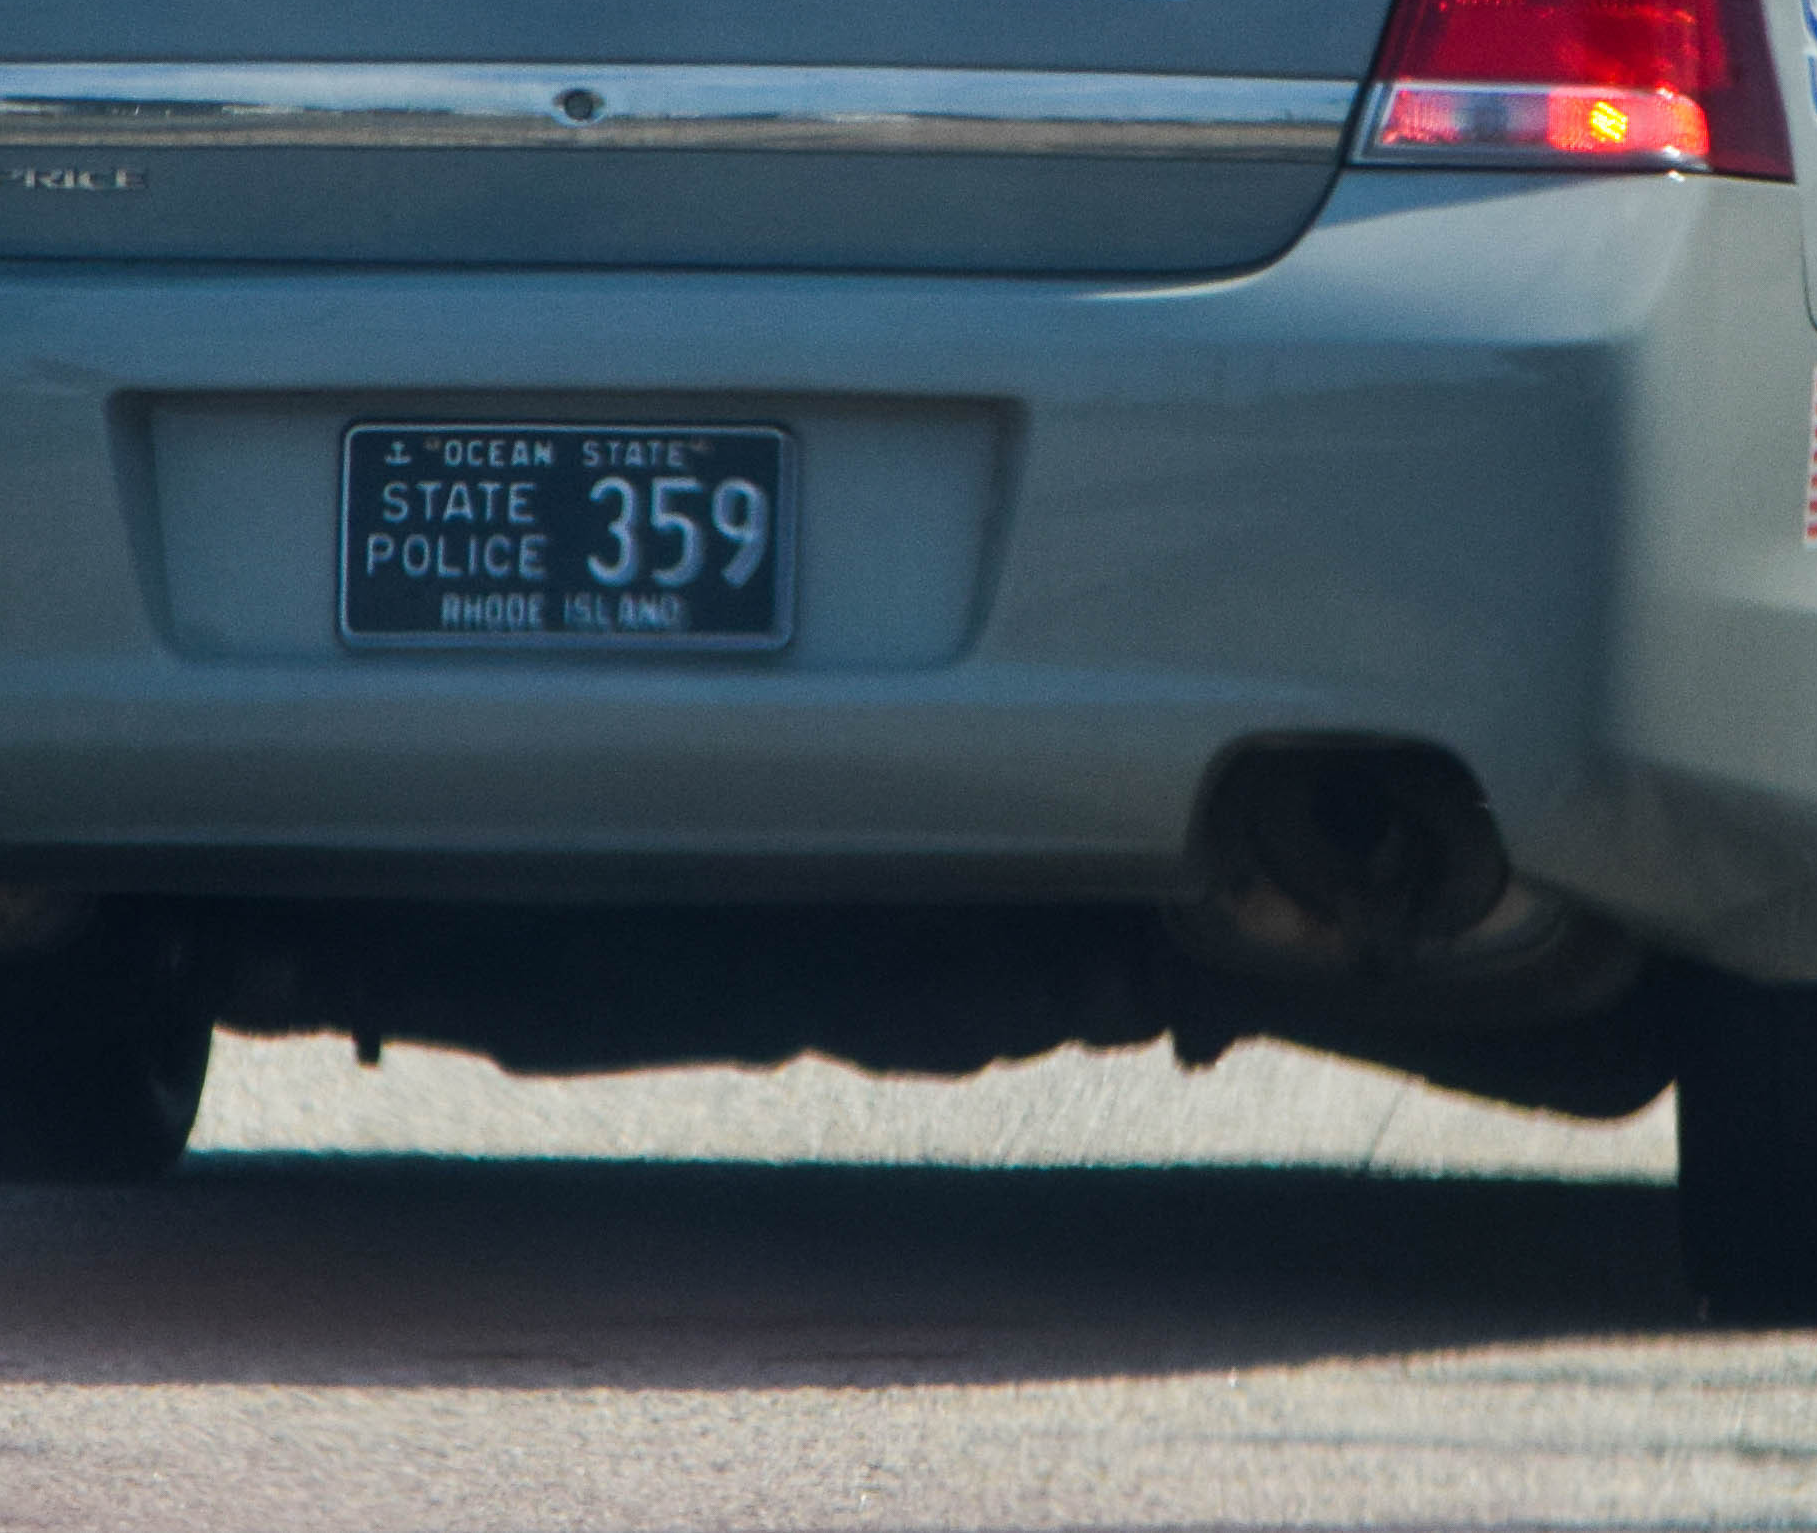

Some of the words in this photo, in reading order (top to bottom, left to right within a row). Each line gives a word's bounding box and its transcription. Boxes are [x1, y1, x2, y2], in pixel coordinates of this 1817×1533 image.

[382, 480, 537, 524] STATE
[586, 476, 771, 588] 359
[366, 533, 548, 580] POLICE
[441, 593, 544, 628] RHODE
[563, 593, 684, 627] ISLAND
